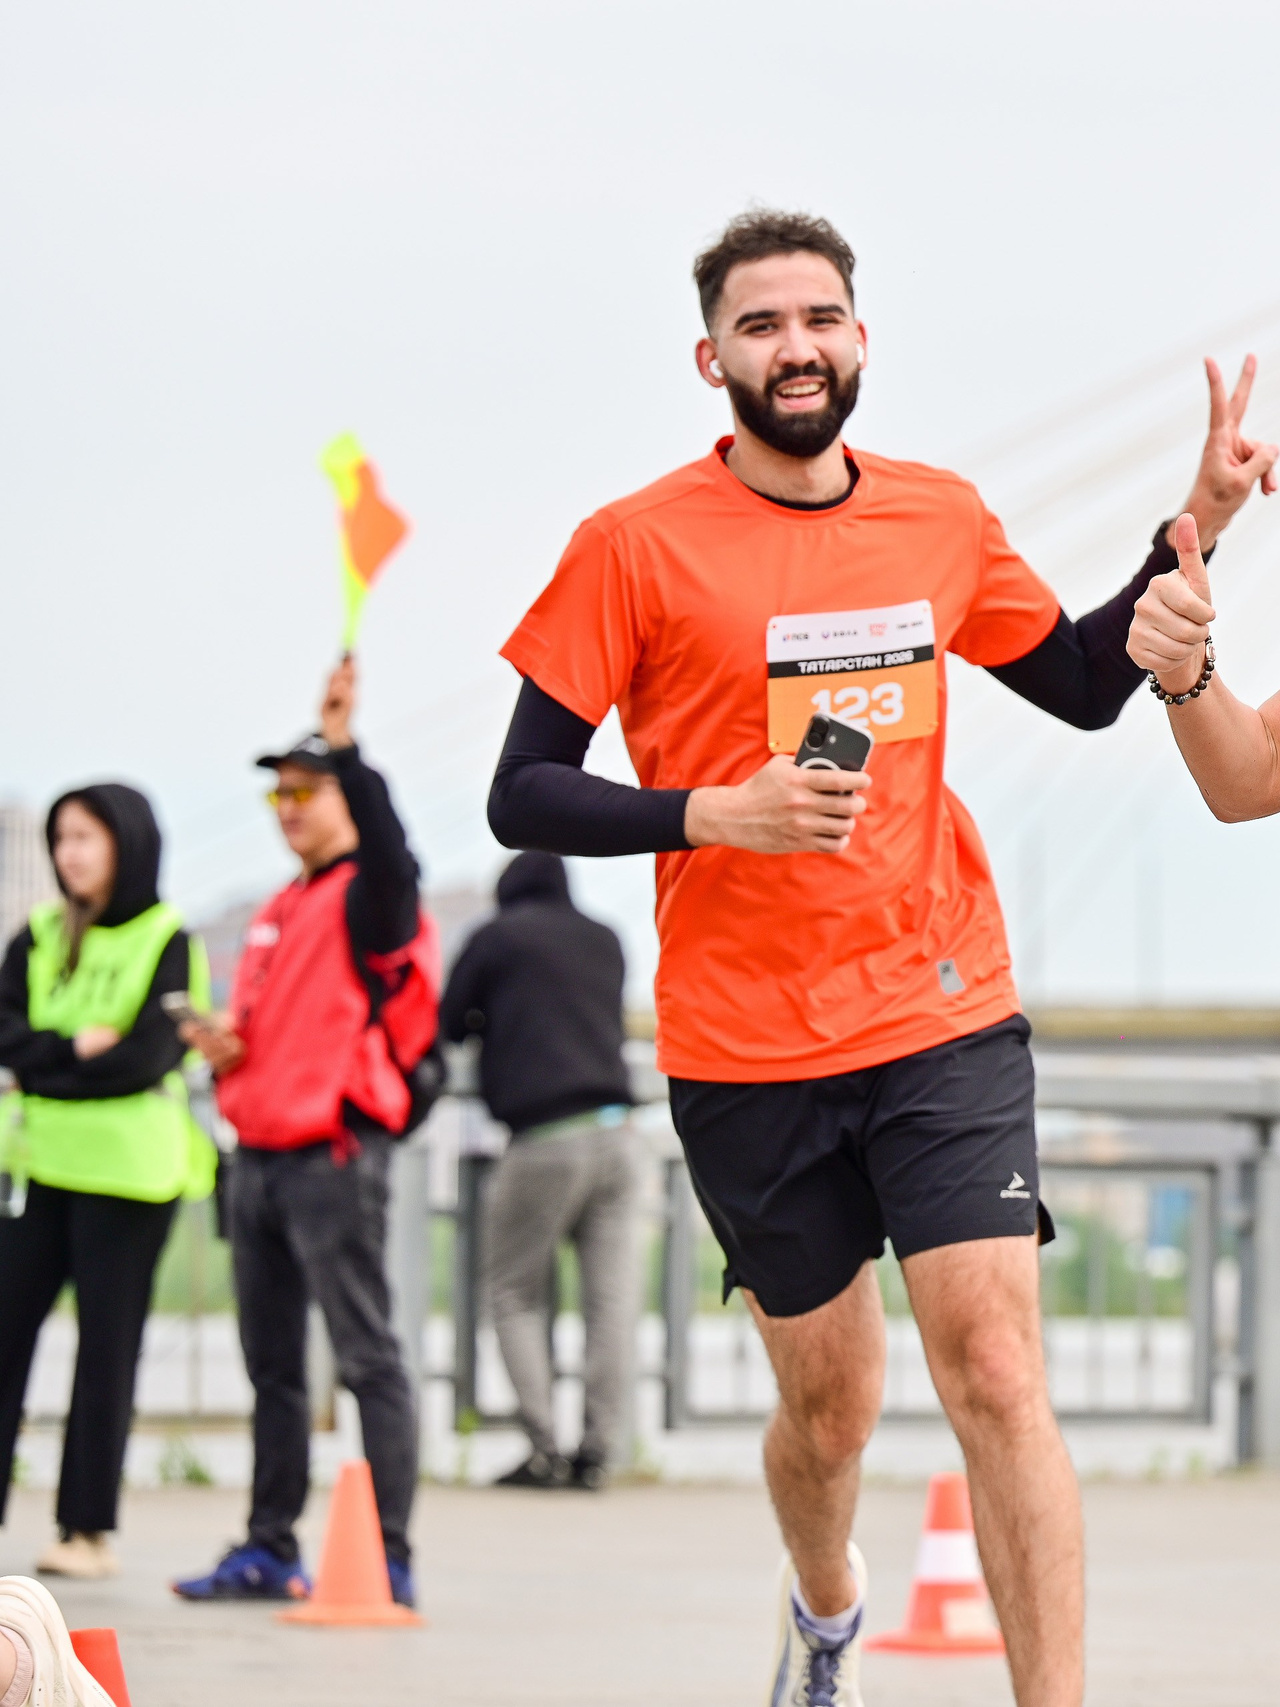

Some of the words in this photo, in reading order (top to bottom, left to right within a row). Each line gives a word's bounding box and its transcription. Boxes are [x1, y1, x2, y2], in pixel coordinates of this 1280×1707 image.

[798, 655, 881, 674] ТАТАРСТАН
[884, 650, 915, 666] 2026
[811, 682, 904, 728] 123
